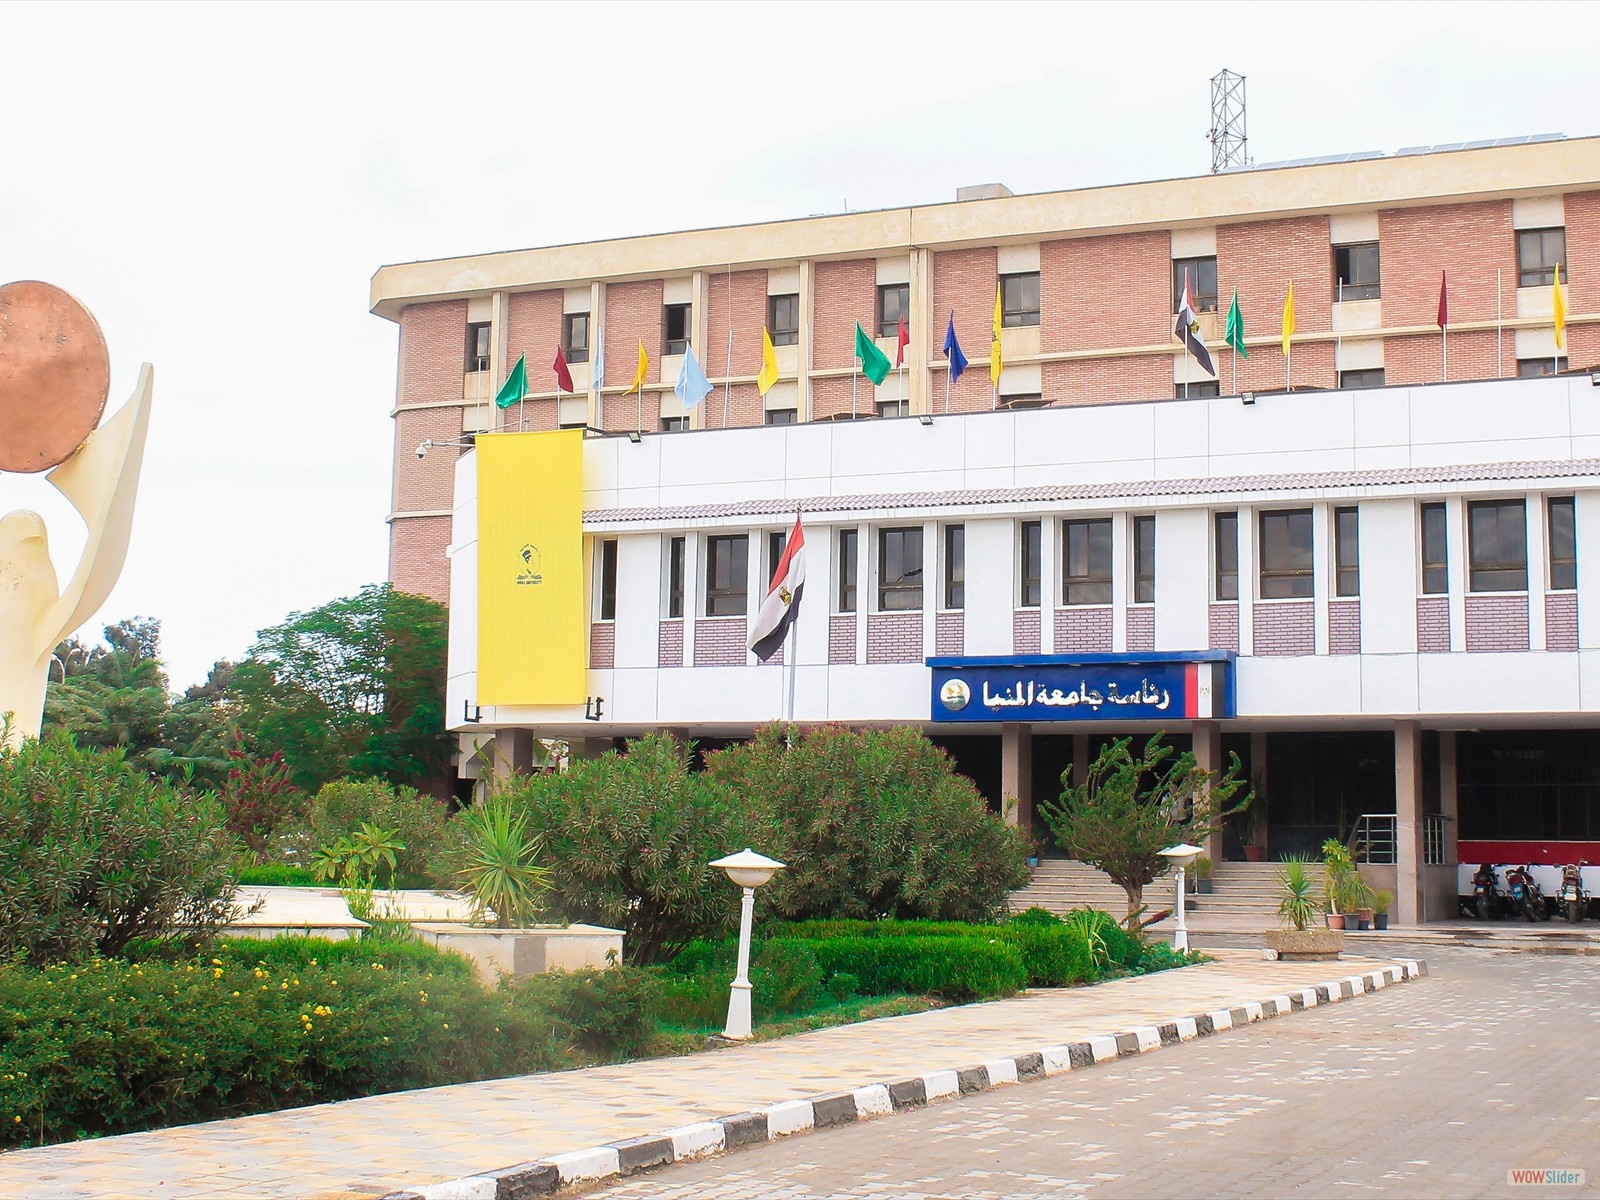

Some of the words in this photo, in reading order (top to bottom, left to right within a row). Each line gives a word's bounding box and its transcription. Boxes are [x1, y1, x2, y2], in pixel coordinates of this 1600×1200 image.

[982, 680, 1035, 711] المنيا
[1036, 679, 1103, 710] جامعة
[1107, 678, 1170, 710] رئاسة
